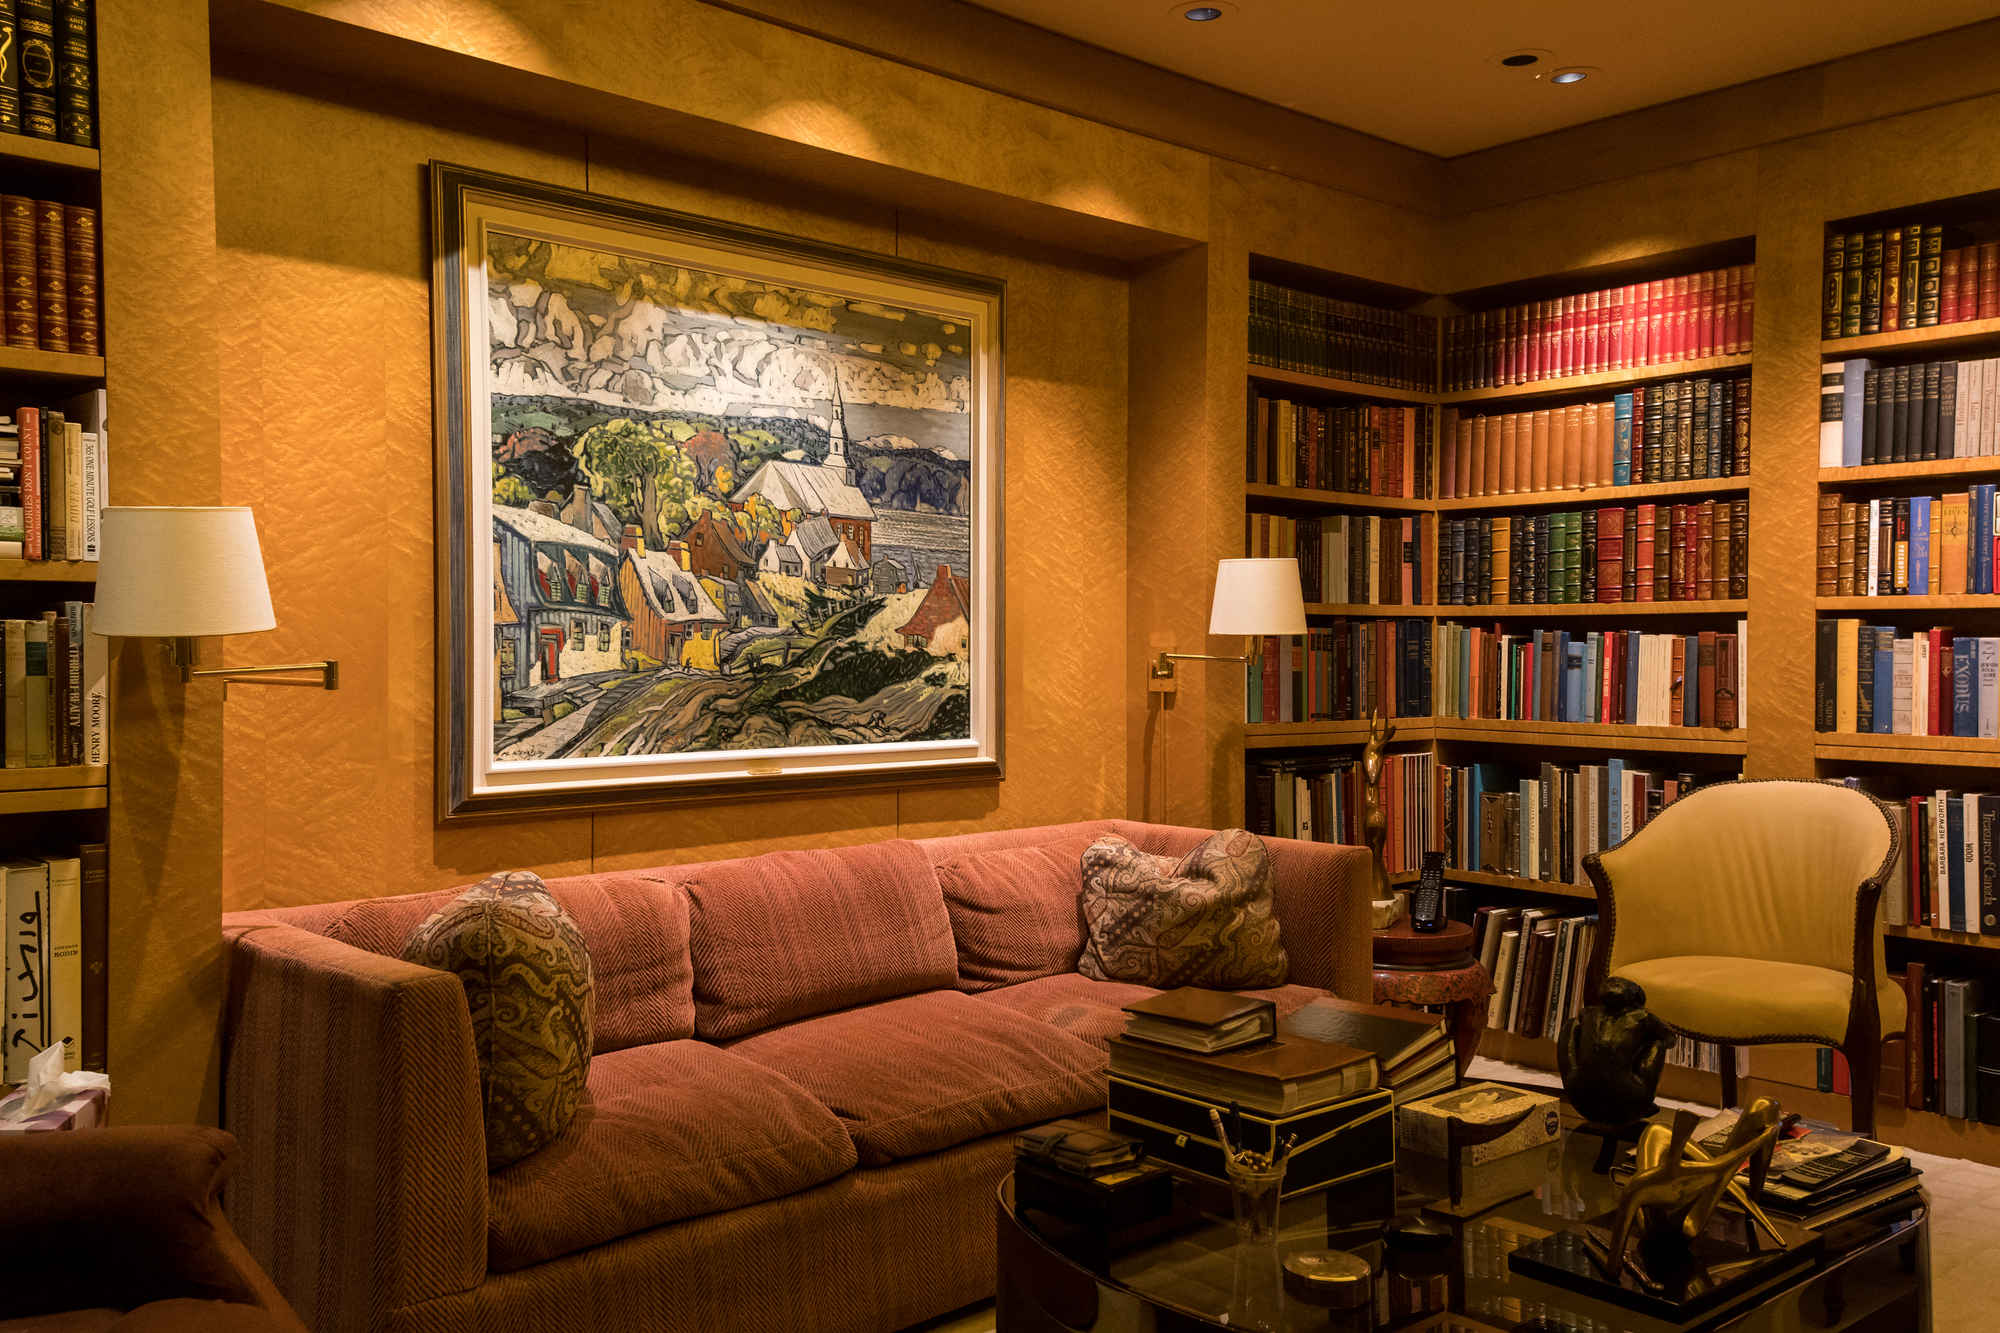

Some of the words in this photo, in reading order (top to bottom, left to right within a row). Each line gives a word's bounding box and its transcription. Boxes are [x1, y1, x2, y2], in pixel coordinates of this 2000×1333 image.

[23, 427, 33, 460] COUNT
[23, 494, 34, 541] CALORIES
[86, 497, 95, 514] GOLF
[87, 514, 96, 542] LESSONS
[1954, 654, 1970, 713] EXODUS
[69, 689, 81, 727] BEAUTY
[91, 692, 101, 728] MOORE
[91, 731, 101, 763] HENRY
[1938, 799, 1946, 839] HEPWORTH
[1983, 809, 1996, 855] Treasures
[1965, 842, 1975, 863] WOOD
[1983, 855, 1997, 867] of
[1983, 867, 1998, 906] Canada
